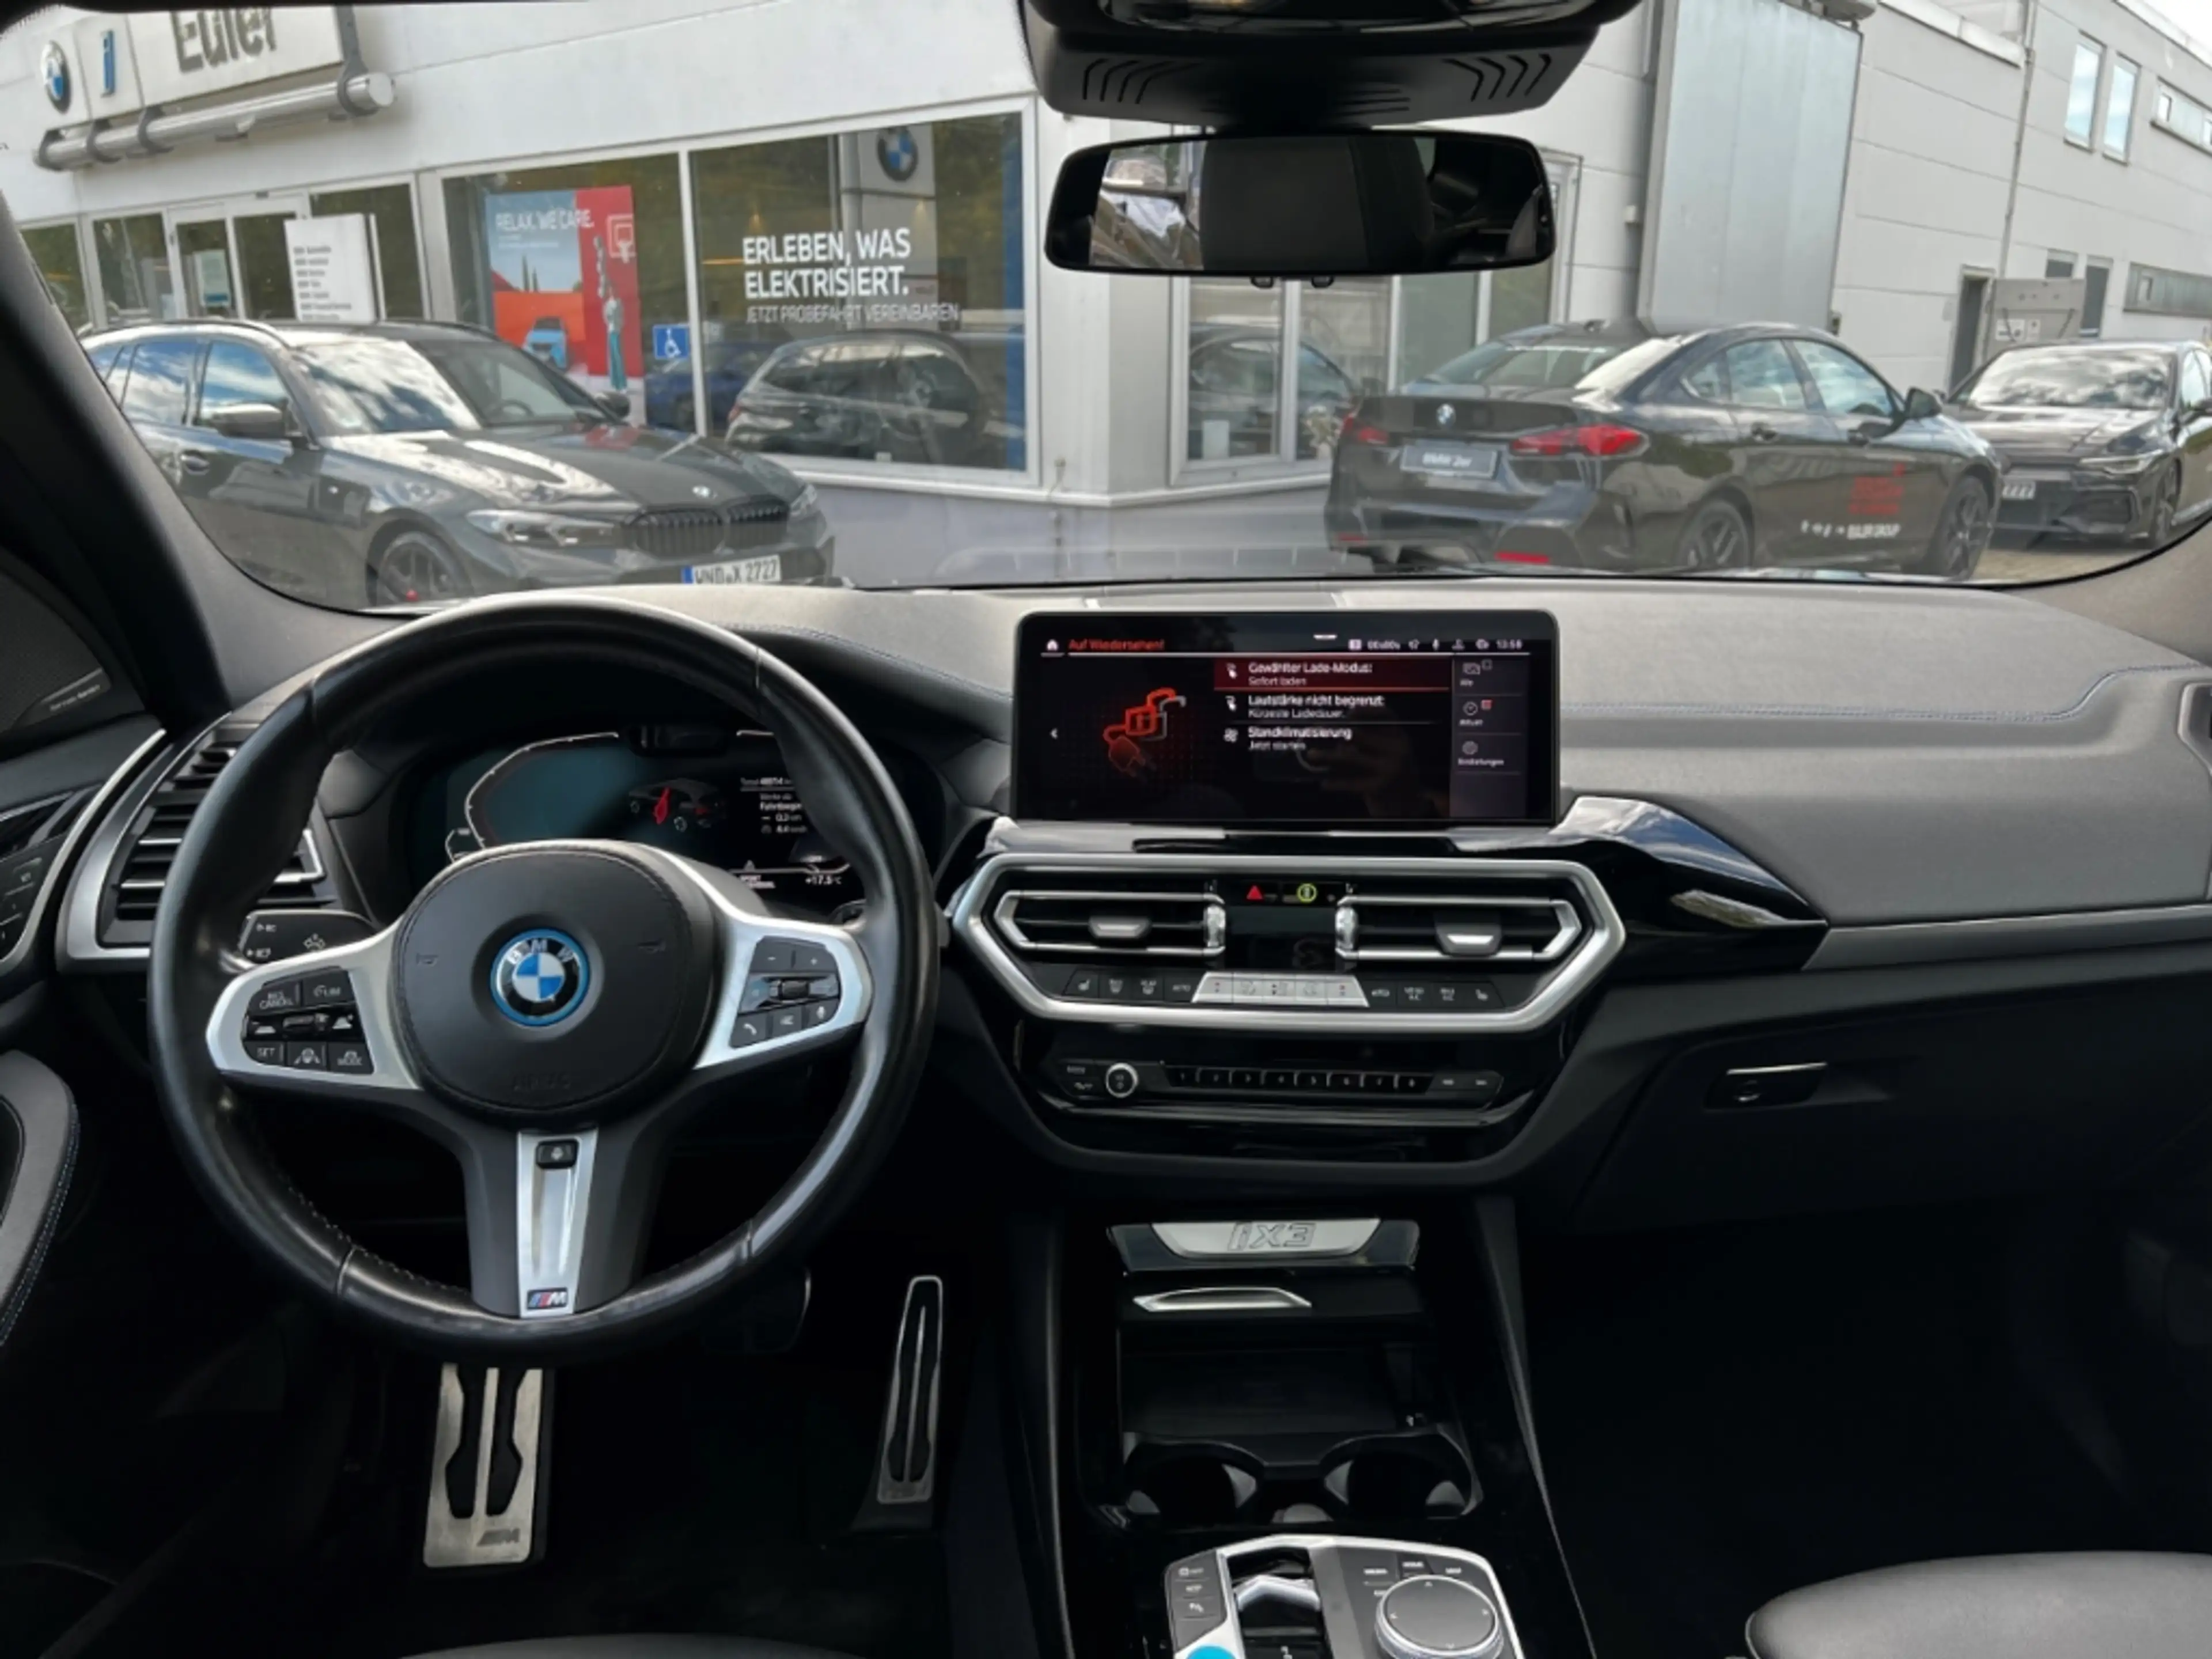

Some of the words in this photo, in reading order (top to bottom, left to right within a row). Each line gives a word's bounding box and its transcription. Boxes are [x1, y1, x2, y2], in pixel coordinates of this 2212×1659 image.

[742, 232, 851, 267] ERLEBEN,
[856, 228, 911, 259] WAS
[744, 265, 909, 299] ELEKTRISIERT.
[1069, 639, 1088, 650] Auf
[1089, 639, 1165, 650] Wiedersehen!
[1248, 662, 1301, 673] Gewählter
[1248, 695, 1303, 706] Lautstärke
[1305, 695, 1332, 706] nicht
